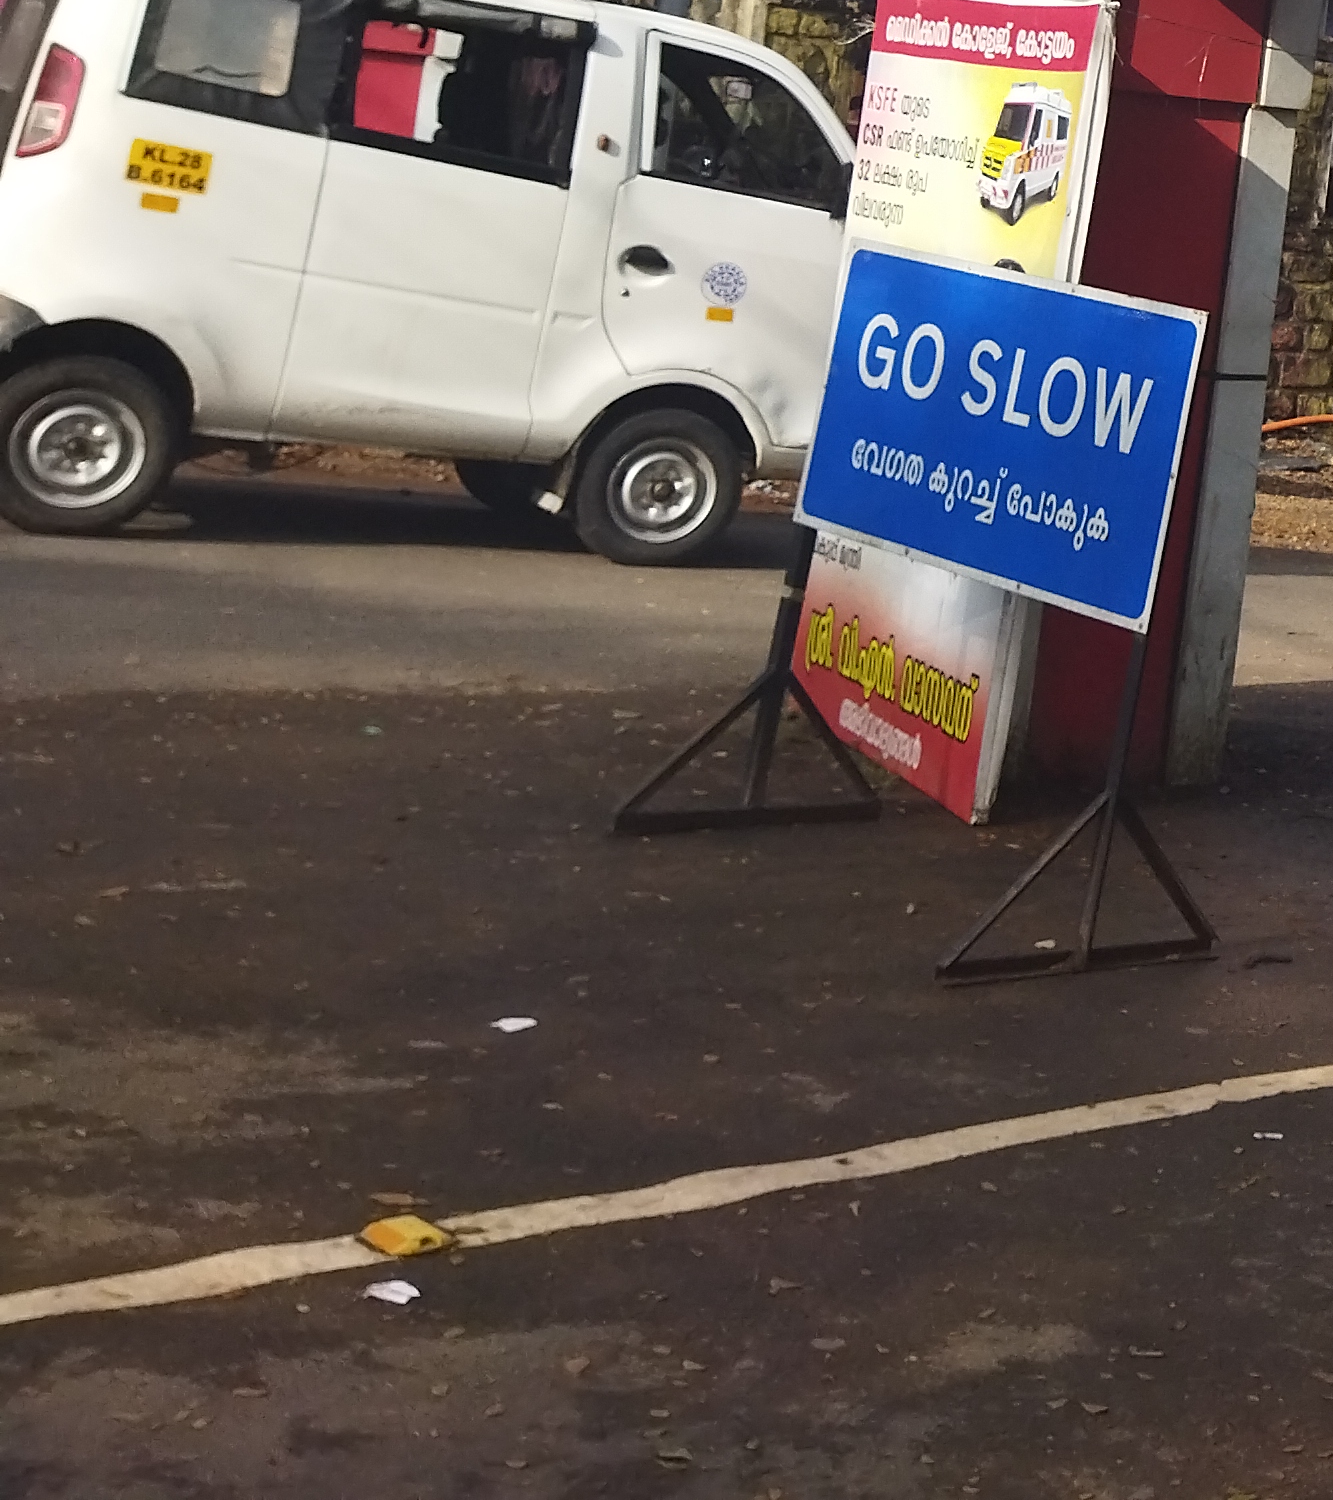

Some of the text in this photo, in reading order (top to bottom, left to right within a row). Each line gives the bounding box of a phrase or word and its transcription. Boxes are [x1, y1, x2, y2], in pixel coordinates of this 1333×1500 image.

[886, 13, 950, 48] മെഡിക്കൽ
[1016, 29, 1075, 64] കോട്ടയം
[867, 84, 899, 113] KSFE
[862, 123, 884, 147] CSR
[856, 158, 870, 181] 32
[858, 313, 1154, 454] GO SLOW
[852, 438, 1110, 551] വേഗത കുറച്ച് പോകുക
